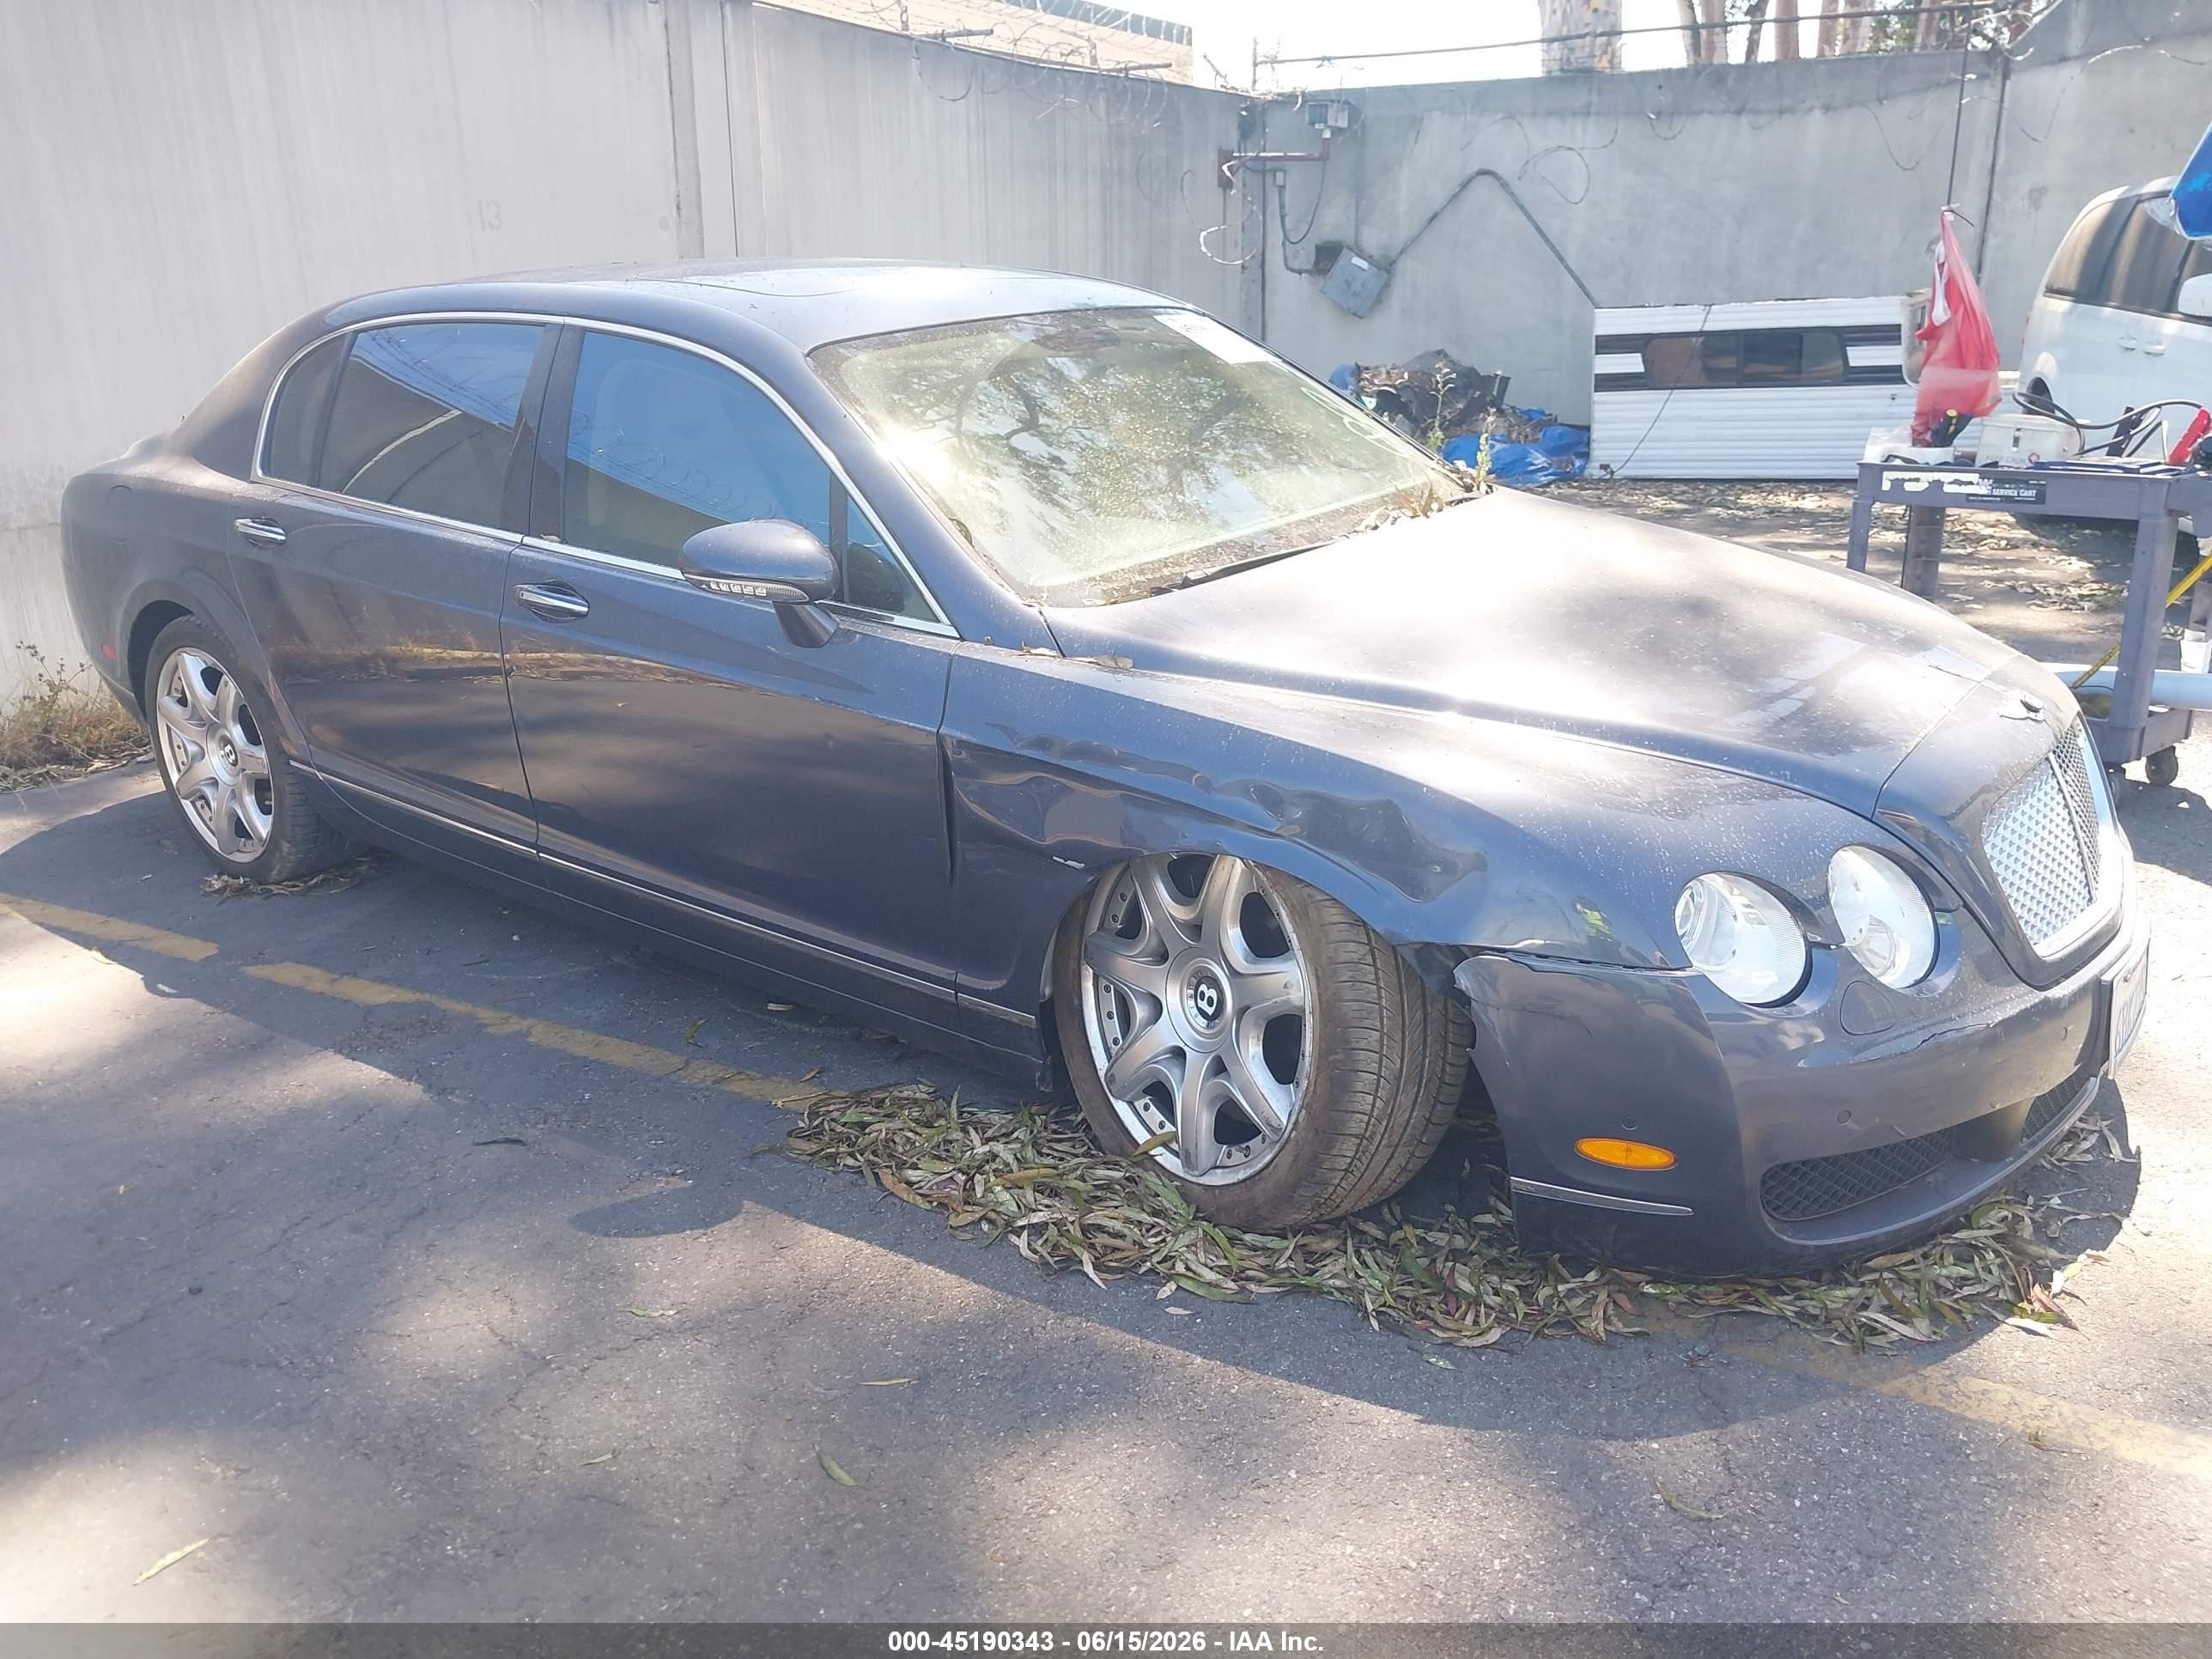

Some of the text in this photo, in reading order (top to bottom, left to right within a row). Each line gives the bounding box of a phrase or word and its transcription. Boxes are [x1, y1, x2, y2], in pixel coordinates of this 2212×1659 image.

[1992, 488, 2019, 497] SERVICE
[2019, 489, 2037, 497] CART
[1197, 983, 1218, 1016] B
